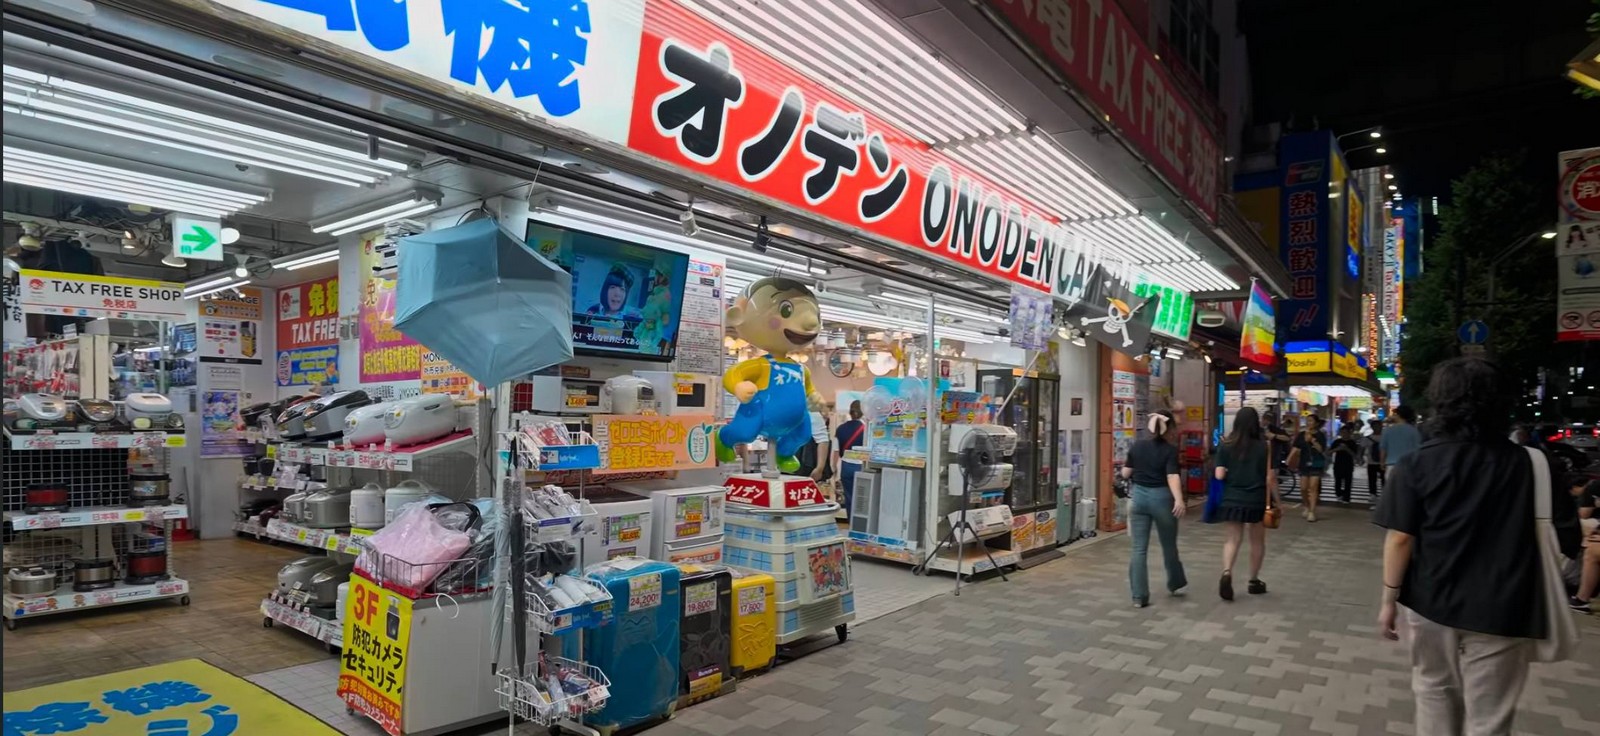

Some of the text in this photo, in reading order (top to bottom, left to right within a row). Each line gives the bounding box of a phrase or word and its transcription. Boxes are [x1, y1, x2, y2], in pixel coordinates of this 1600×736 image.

[256, 0, 591, 118] 機
[1086, 0, 1138, 125] TAX
[1141, 59, 1186, 177] FREE
[656, 41, 909, 223] オノデン
[921, 162, 1055, 288] ONODEN
[52, 281, 181, 301] TAX FREE SHOP
[102, 298, 137, 309] 免税店
[291, 317, 341, 344] TAX FREE
[608, 445, 676, 469] 登録店です
[725, 484, 765, 499] オノデン
[788, 486, 817, 500] オノデン
[353, 583, 380, 627] 3F
[351, 622, 404, 670] 防犯カメラ
